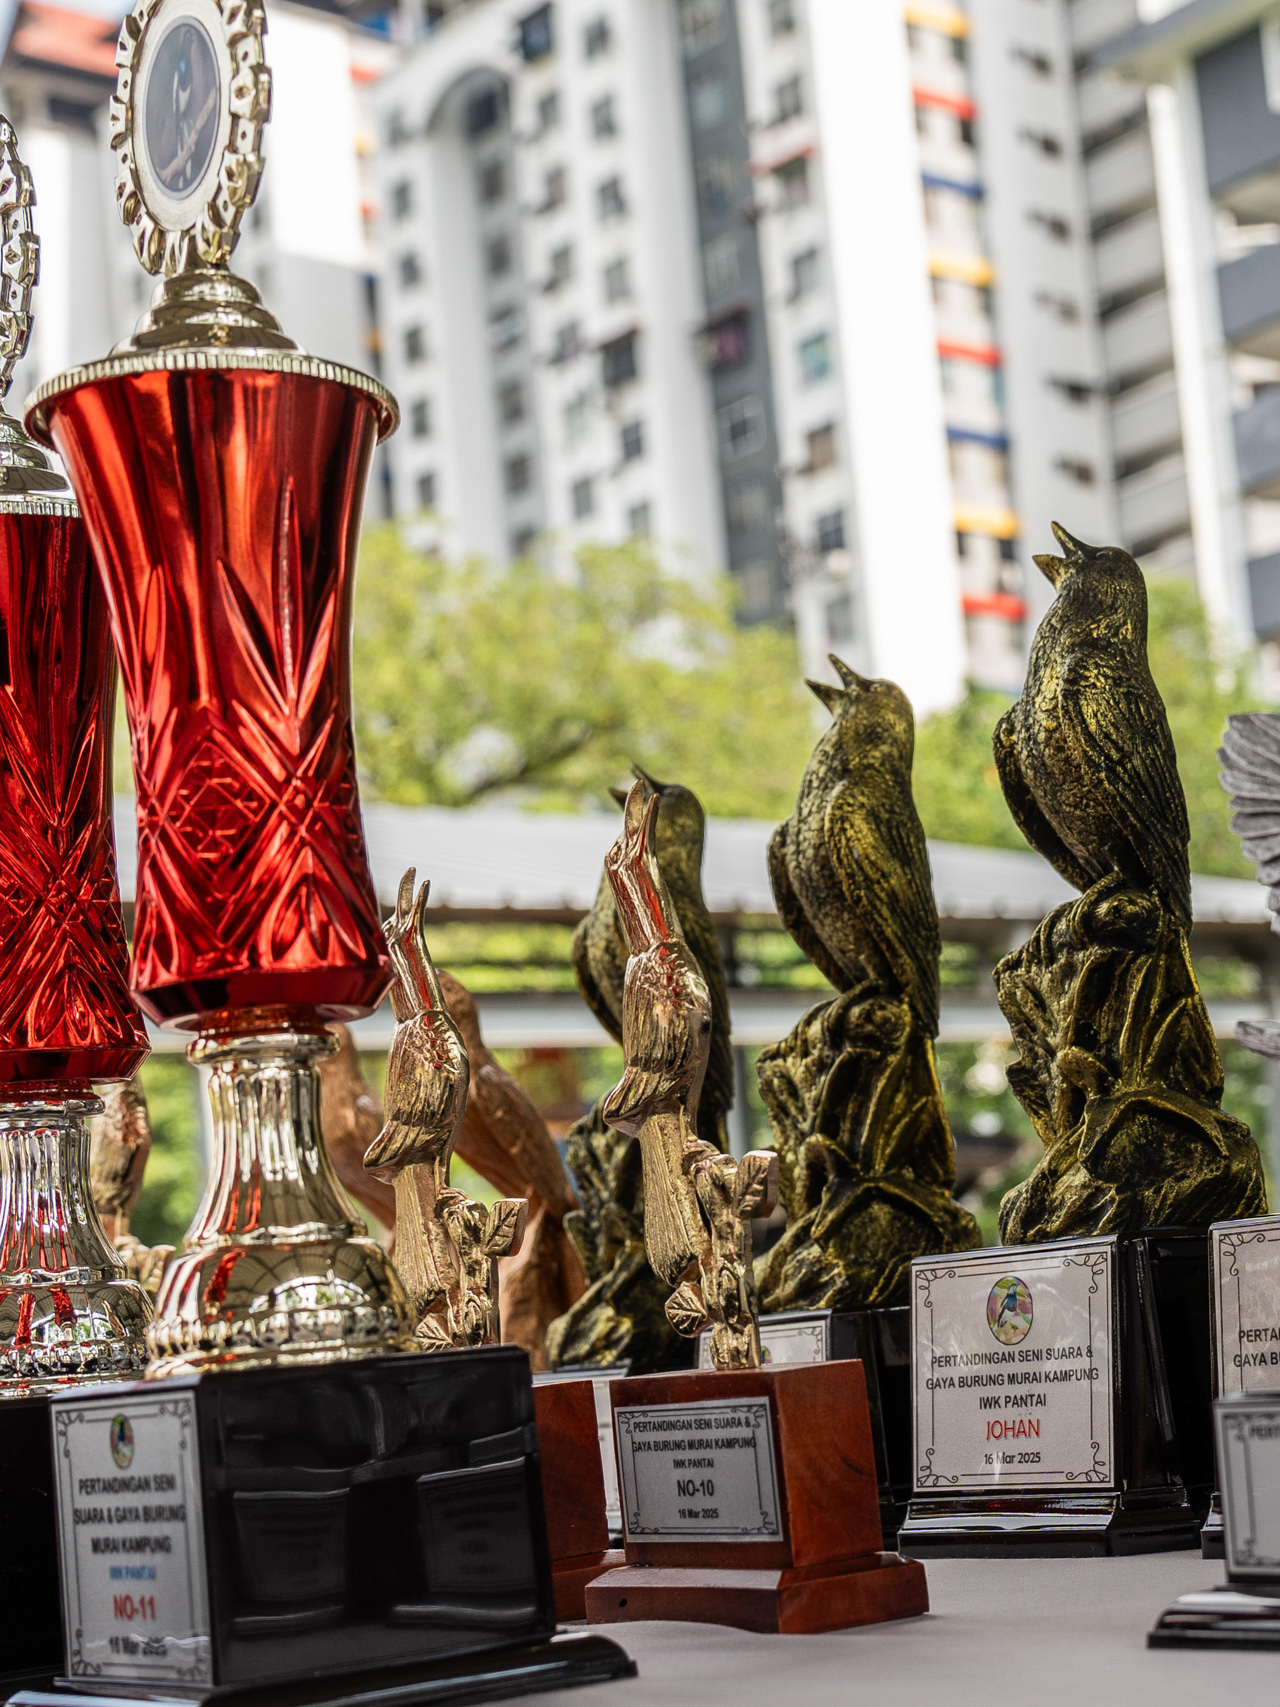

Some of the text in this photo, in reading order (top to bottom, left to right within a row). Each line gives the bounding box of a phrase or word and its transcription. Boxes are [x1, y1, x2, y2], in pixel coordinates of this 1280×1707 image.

[932, 1345, 1093, 1368] PERTANDINGAN SENI SUARA &
[1233, 1353, 1268, 1368] GAYA
[926, 1368, 1099, 1390] GAYA BURUNG MURAI KAMPUNG
[979, 1393, 1046, 1410] IWK PANTAI
[634, 1417, 751, 1432] PERTANDINGAN SENI SUARA &
[986, 1419, 1040, 1441] JOHAN
[632, 1436, 756, 1452] GAYA BURUNG MURAI KAMPUNG
[673, 1458, 714, 1469] IWK PANTAI
[985, 1452, 1041, 1465] 16 Mar 2025
[79, 1473, 176, 1495] PERTANDINGAN SENI
[677, 1479, 714, 1497] NO-10
[74, 1504, 186, 1524] SUARA & GAYA BURUNG
[678, 1508, 719, 1519] 16 Mar 2025
[92, 1536, 172, 1554] MURAI KAMPUNG
[113, 1594, 155, 1620] NO-11
